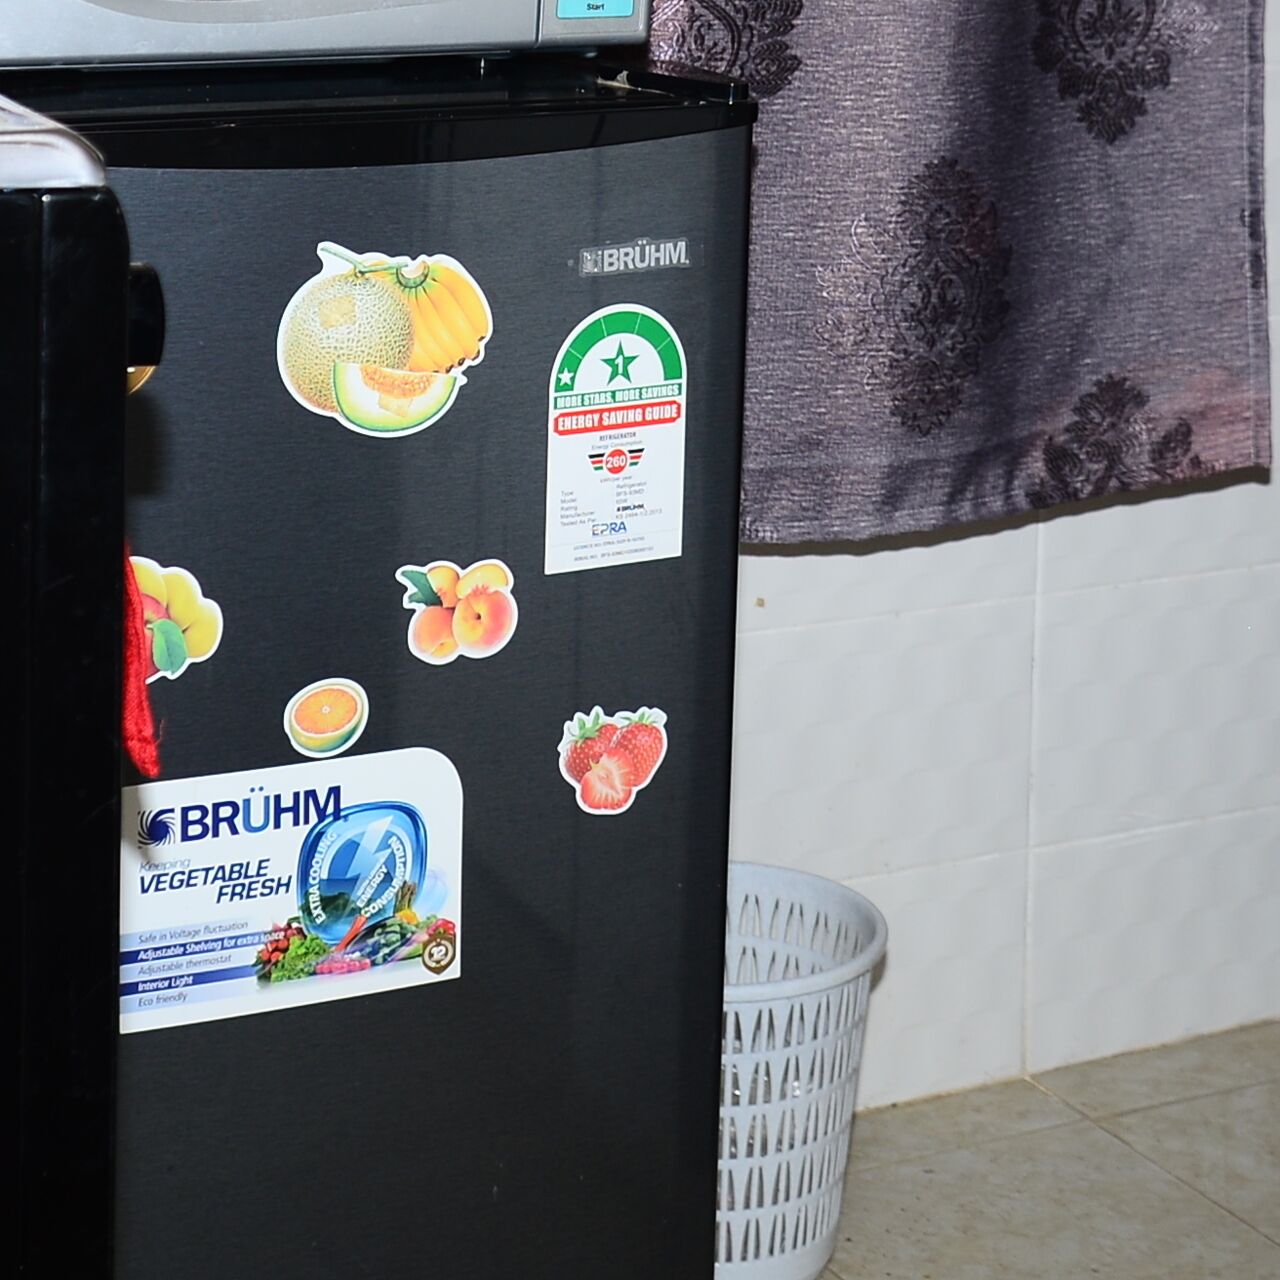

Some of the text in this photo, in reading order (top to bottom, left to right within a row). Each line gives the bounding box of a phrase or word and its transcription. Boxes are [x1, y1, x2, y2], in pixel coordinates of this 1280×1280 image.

[587, 2, 605, 11] Start
[603, 239, 687, 272] BRÜHM
[556, 395, 583, 408] MORE
[615, 389, 640, 402] MORE
[641, 384, 679, 399] SAVINGS
[558, 404, 679, 431] ENERGY SAVING GUIDE
[606, 455, 626, 469] 260
[180, 785, 342, 843] BRÜHM
[140, 858, 270, 894] VEGETABLE
[216, 875, 292, 904] FRESH
[308, 831, 338, 925] EXTRA COOLING
[356, 863, 388, 908] ENERGY
[138, 933, 157, 944] Safe
[169, 927, 201, 940] Voltage
[203, 921, 248, 934] fluctuation
[138, 945, 184, 962] Adjustable
[185, 939, 221, 954] Shelving
[223, 936, 236, 948] for
[237, 935, 259, 946] extra
[138, 954, 232, 977] Adjustable thermostat
[138, 975, 194, 992] Interior Light
[138, 992, 188, 1007] Eco friendly
